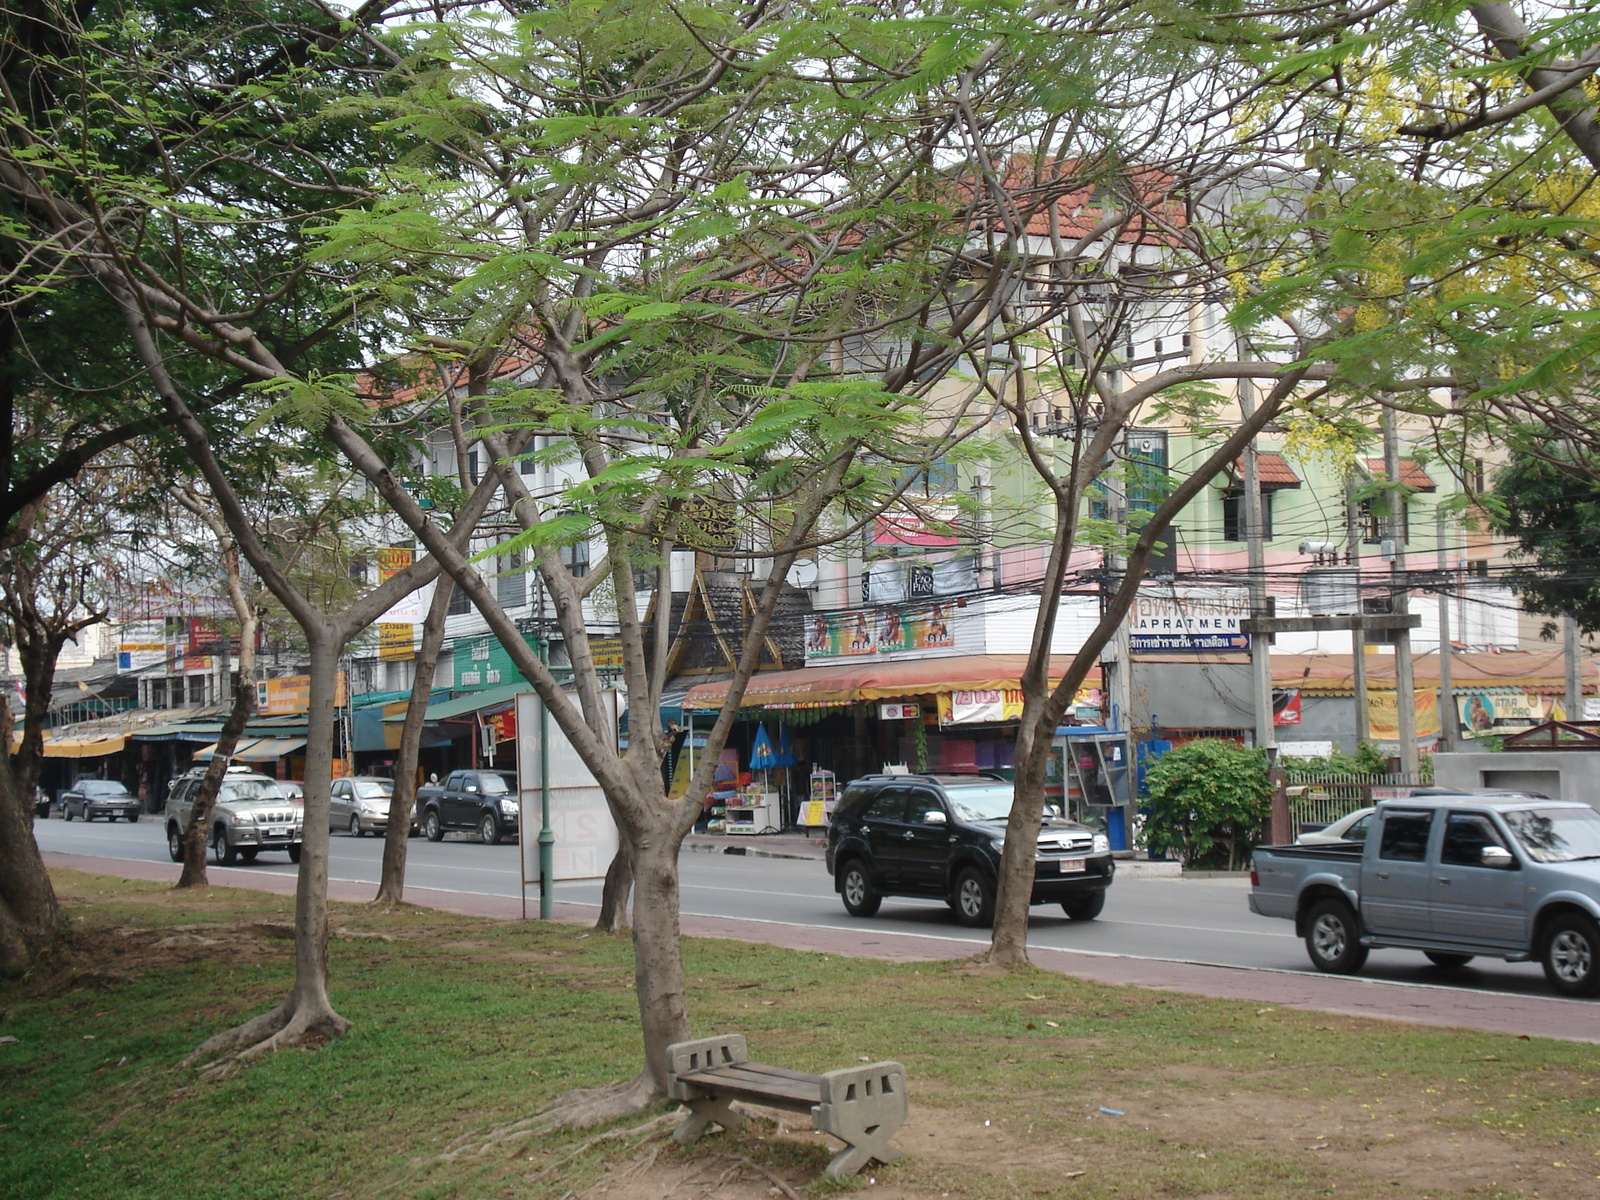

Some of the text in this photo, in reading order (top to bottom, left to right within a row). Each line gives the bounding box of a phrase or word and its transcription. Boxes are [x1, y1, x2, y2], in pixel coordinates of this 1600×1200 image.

[1140, 619, 1236, 629] APRATMEN
[1495, 698, 1518, 708] STAR
[1511, 707, 1531, 717] PRO
